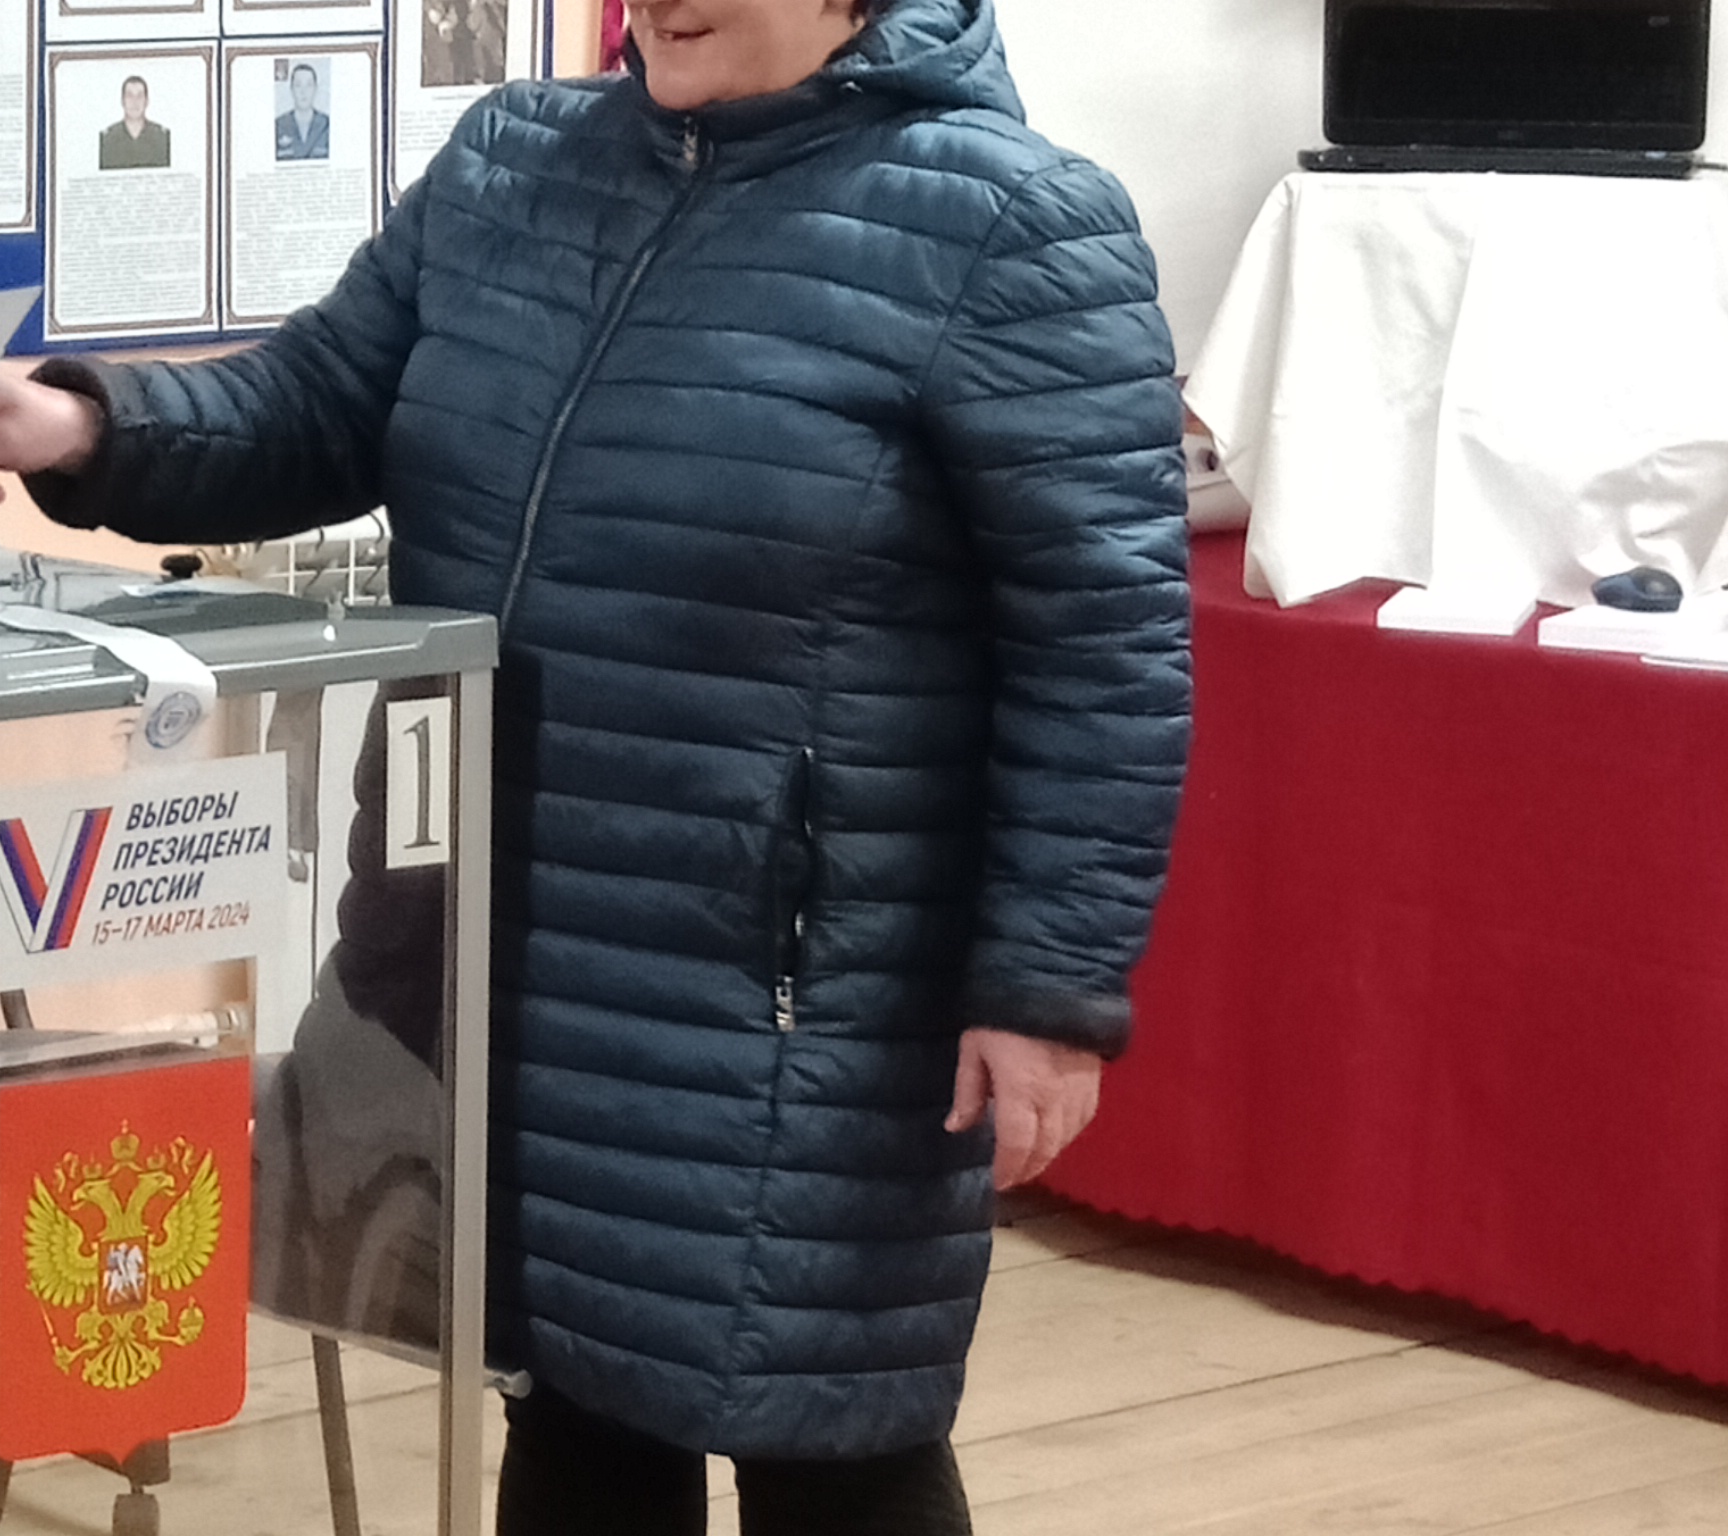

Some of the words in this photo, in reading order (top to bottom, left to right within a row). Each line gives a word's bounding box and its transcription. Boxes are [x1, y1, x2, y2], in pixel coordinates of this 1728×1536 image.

[404, 715, 441, 850] 1
[125, 790, 239, 831] ВЫБОРЫ
[113, 824, 272, 871] ПРЕЗИДЕНТА
[100, 870, 205, 912] РОССИИ
[143, 907, 206, 938] МАРТА
[207, 900, 252, 930] 2024
